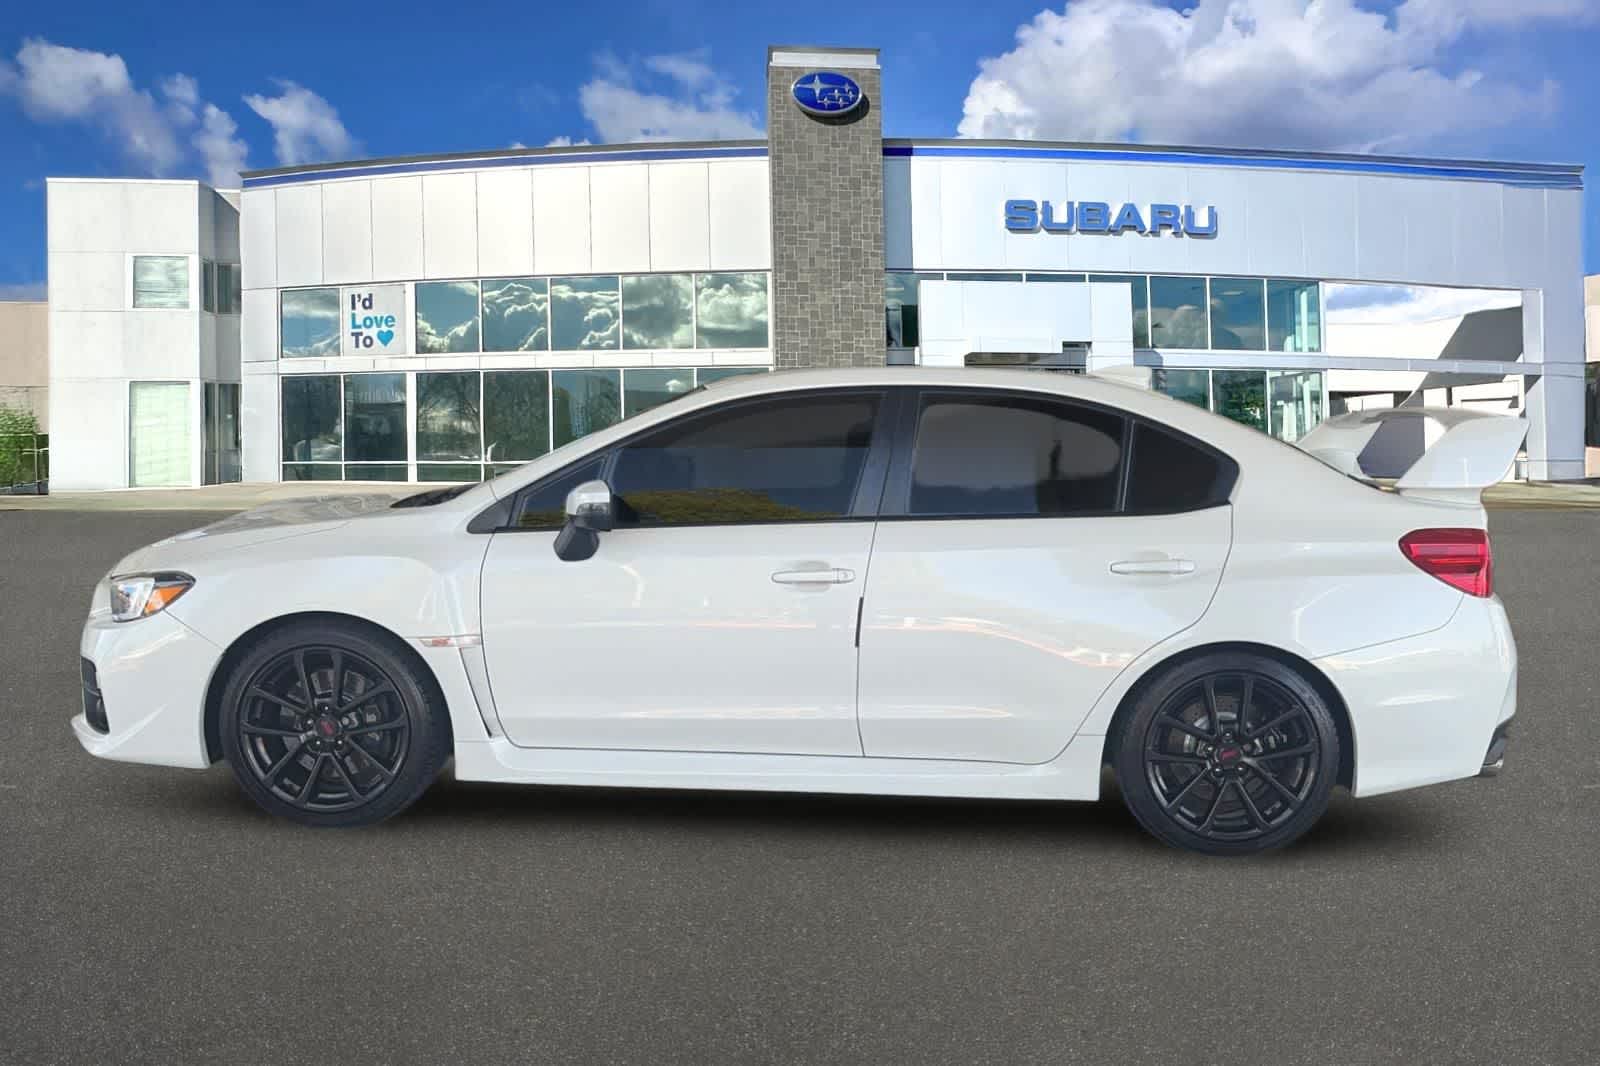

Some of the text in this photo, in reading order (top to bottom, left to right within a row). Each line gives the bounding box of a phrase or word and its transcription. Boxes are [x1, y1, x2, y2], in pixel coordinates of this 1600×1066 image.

[1005, 199, 1217, 238] SUBARU
[351, 293, 373, 310] I'd
[351, 312, 396, 329] Love
[351, 332, 374, 348] To
